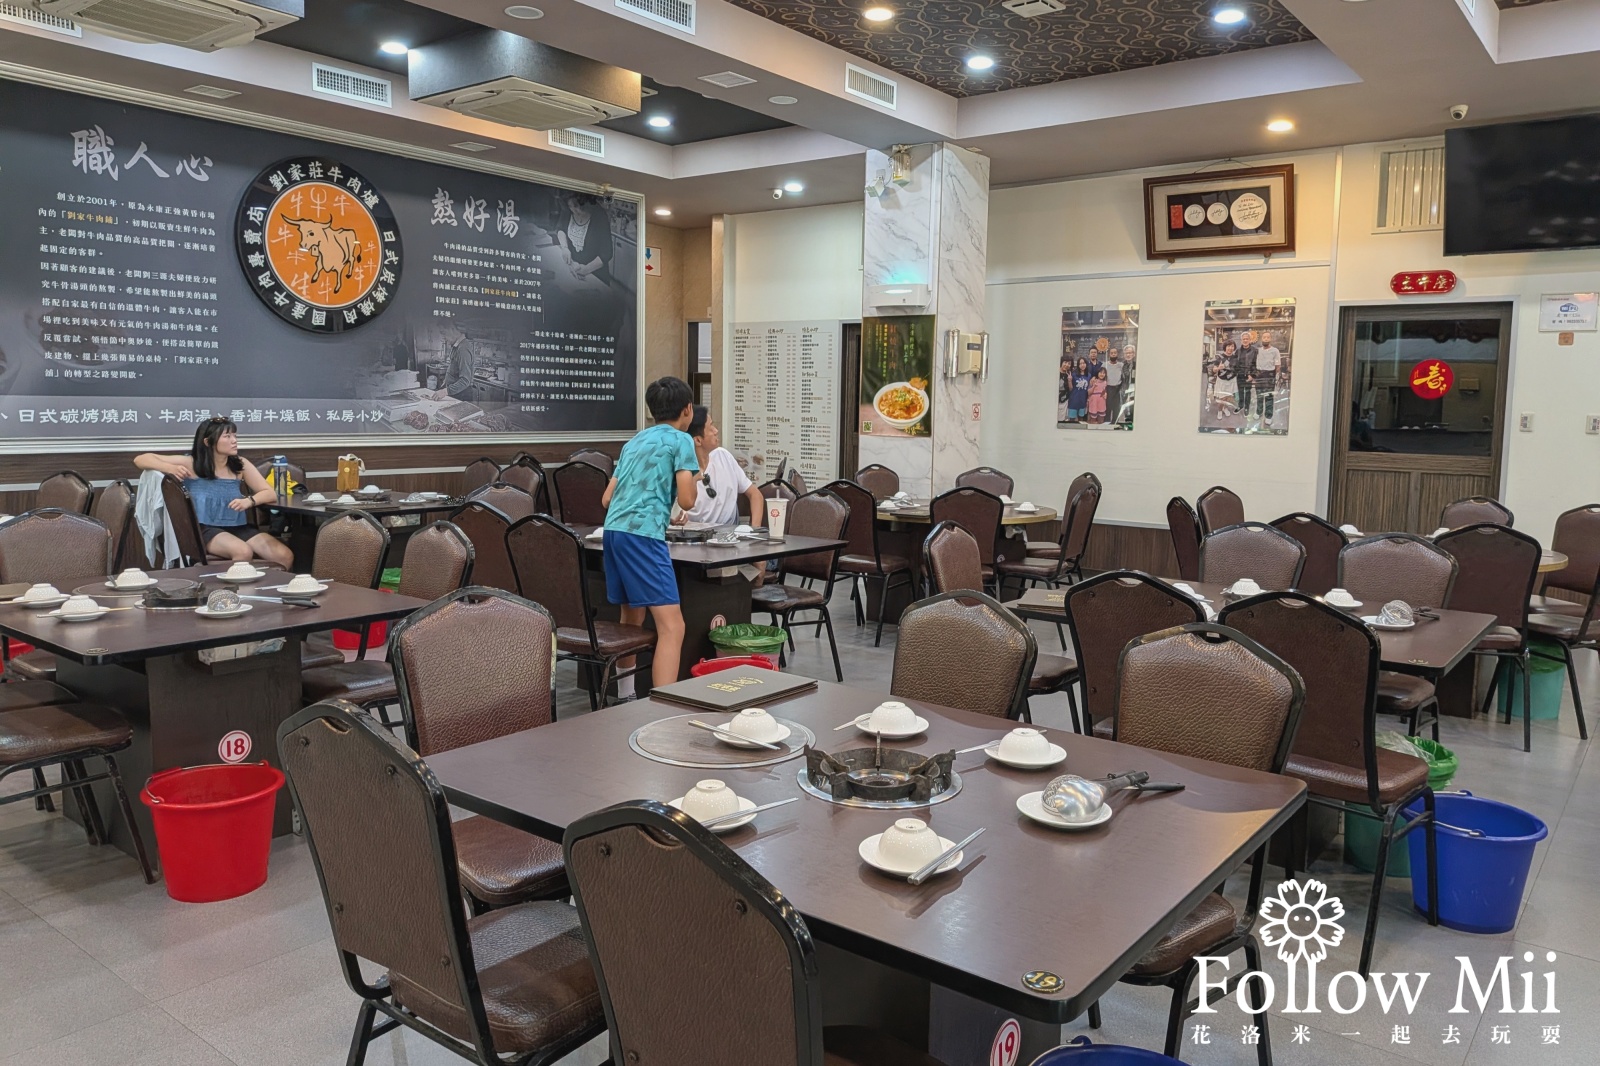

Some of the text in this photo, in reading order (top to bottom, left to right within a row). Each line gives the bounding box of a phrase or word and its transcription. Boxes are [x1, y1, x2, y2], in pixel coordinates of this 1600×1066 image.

[69, 124, 213, 181] 職人心
[268, 161, 380, 210] 劉家莊牛肉爐
[226, 738, 245, 758] 18
[1028, 972, 1057, 988] 19
[998, 1031, 1015, 1066] 19
